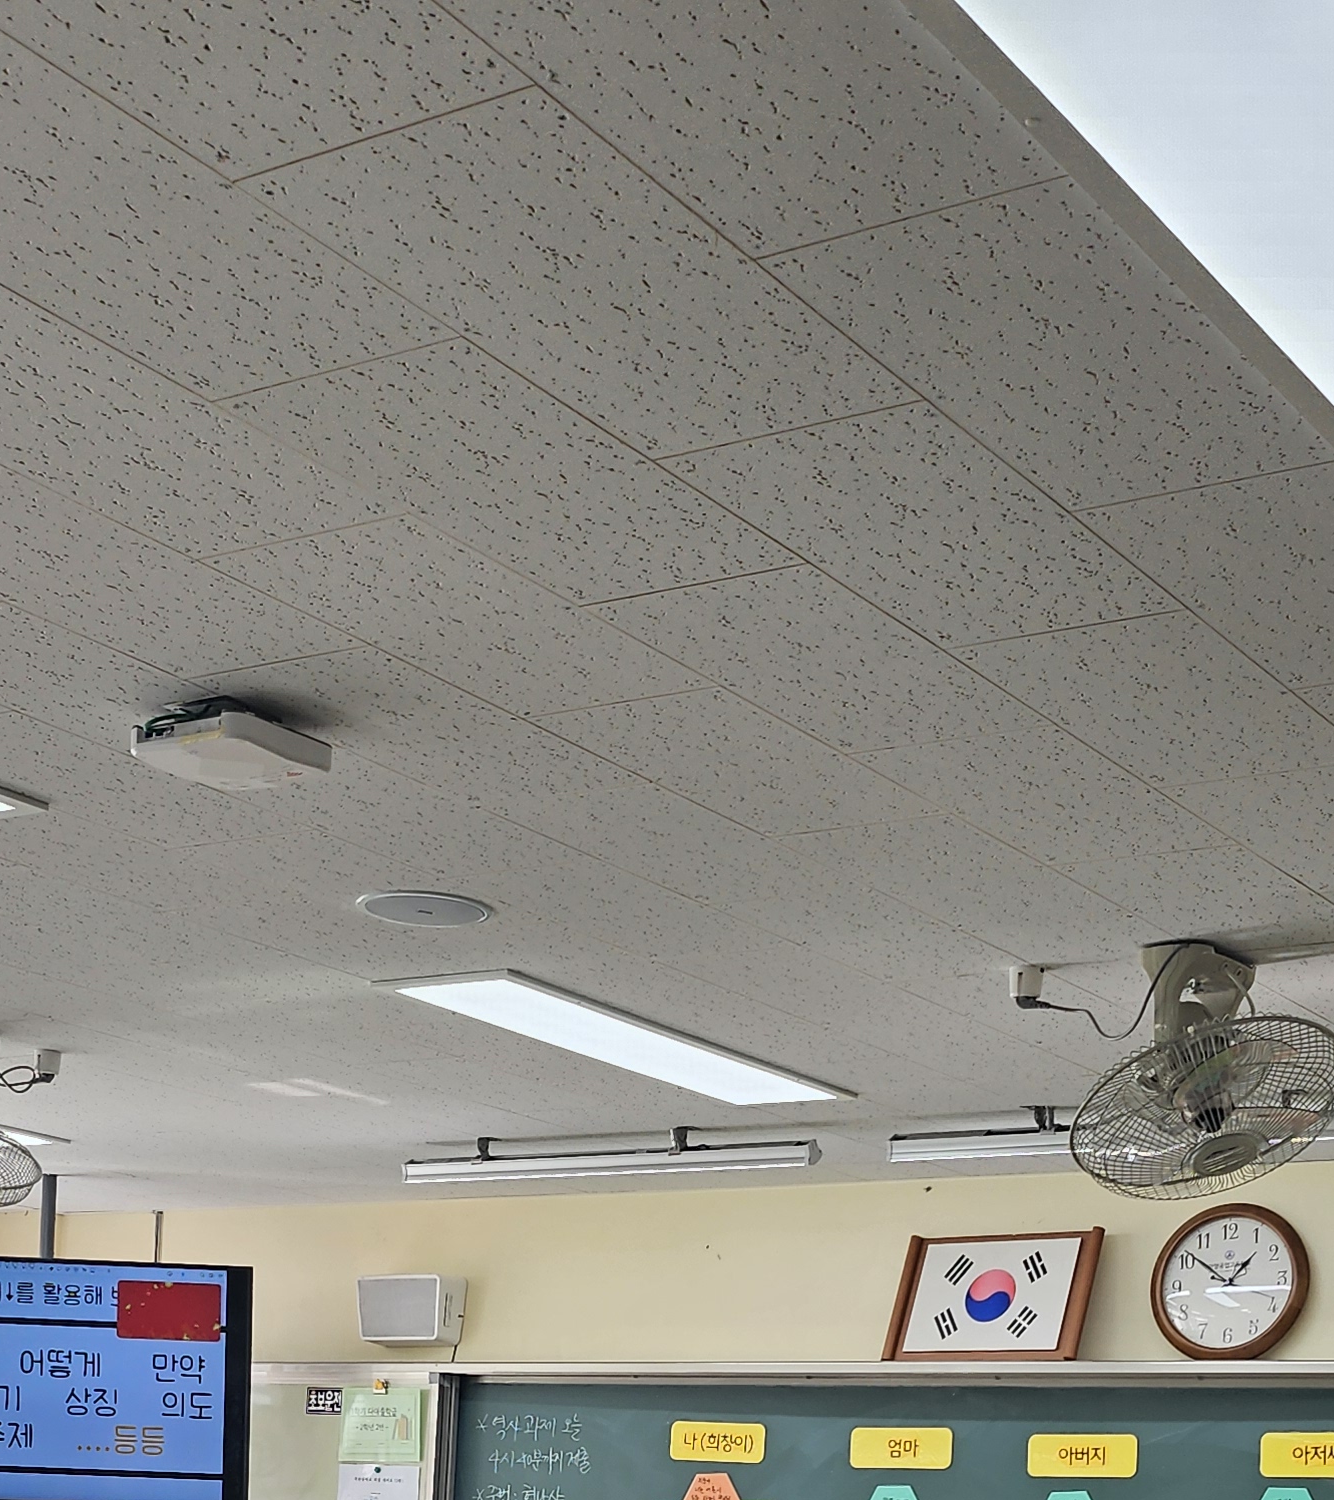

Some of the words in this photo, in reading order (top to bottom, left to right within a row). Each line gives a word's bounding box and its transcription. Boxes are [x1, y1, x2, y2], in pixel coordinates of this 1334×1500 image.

[1222, 1223, 1239, 1240] 12
[1253, 1227, 1259, 1244] 1
[1198, 1233, 1210, 1249] 11
[1179, 1253, 1195, 1269] 10
[1269, 1244, 1279, 1261] 2
[1172, 1280, 1182, 1292] 9
[1277, 1271, 1287, 1285] 3
[17, 1282, 34, 1304] 를
[43, 1283, 103, 1306] 활용해
[1178, 1304, 1189, 1321] 8
[1267, 1297, 1278, 1313] 4
[1198, 1323, 1208, 1339] 7
[1222, 1328, 1233, 1343] 6
[1249, 1319, 1259, 1335] 5
[19, 1349, 102, 1379] 어떻게
[152, 1354, 206, 1384] 만약
[65, 1387, 118, 1417] 상징
[161, 1391, 213, 1420] 의도
[492, 1415, 521, 1441] 역사
[523, 1415, 556, 1441] 과제
[888, 1439, 919, 1458] 엄마
[1058, 1446, 1106, 1465] 아버지
[488, 1449, 515, 1474] 4시
